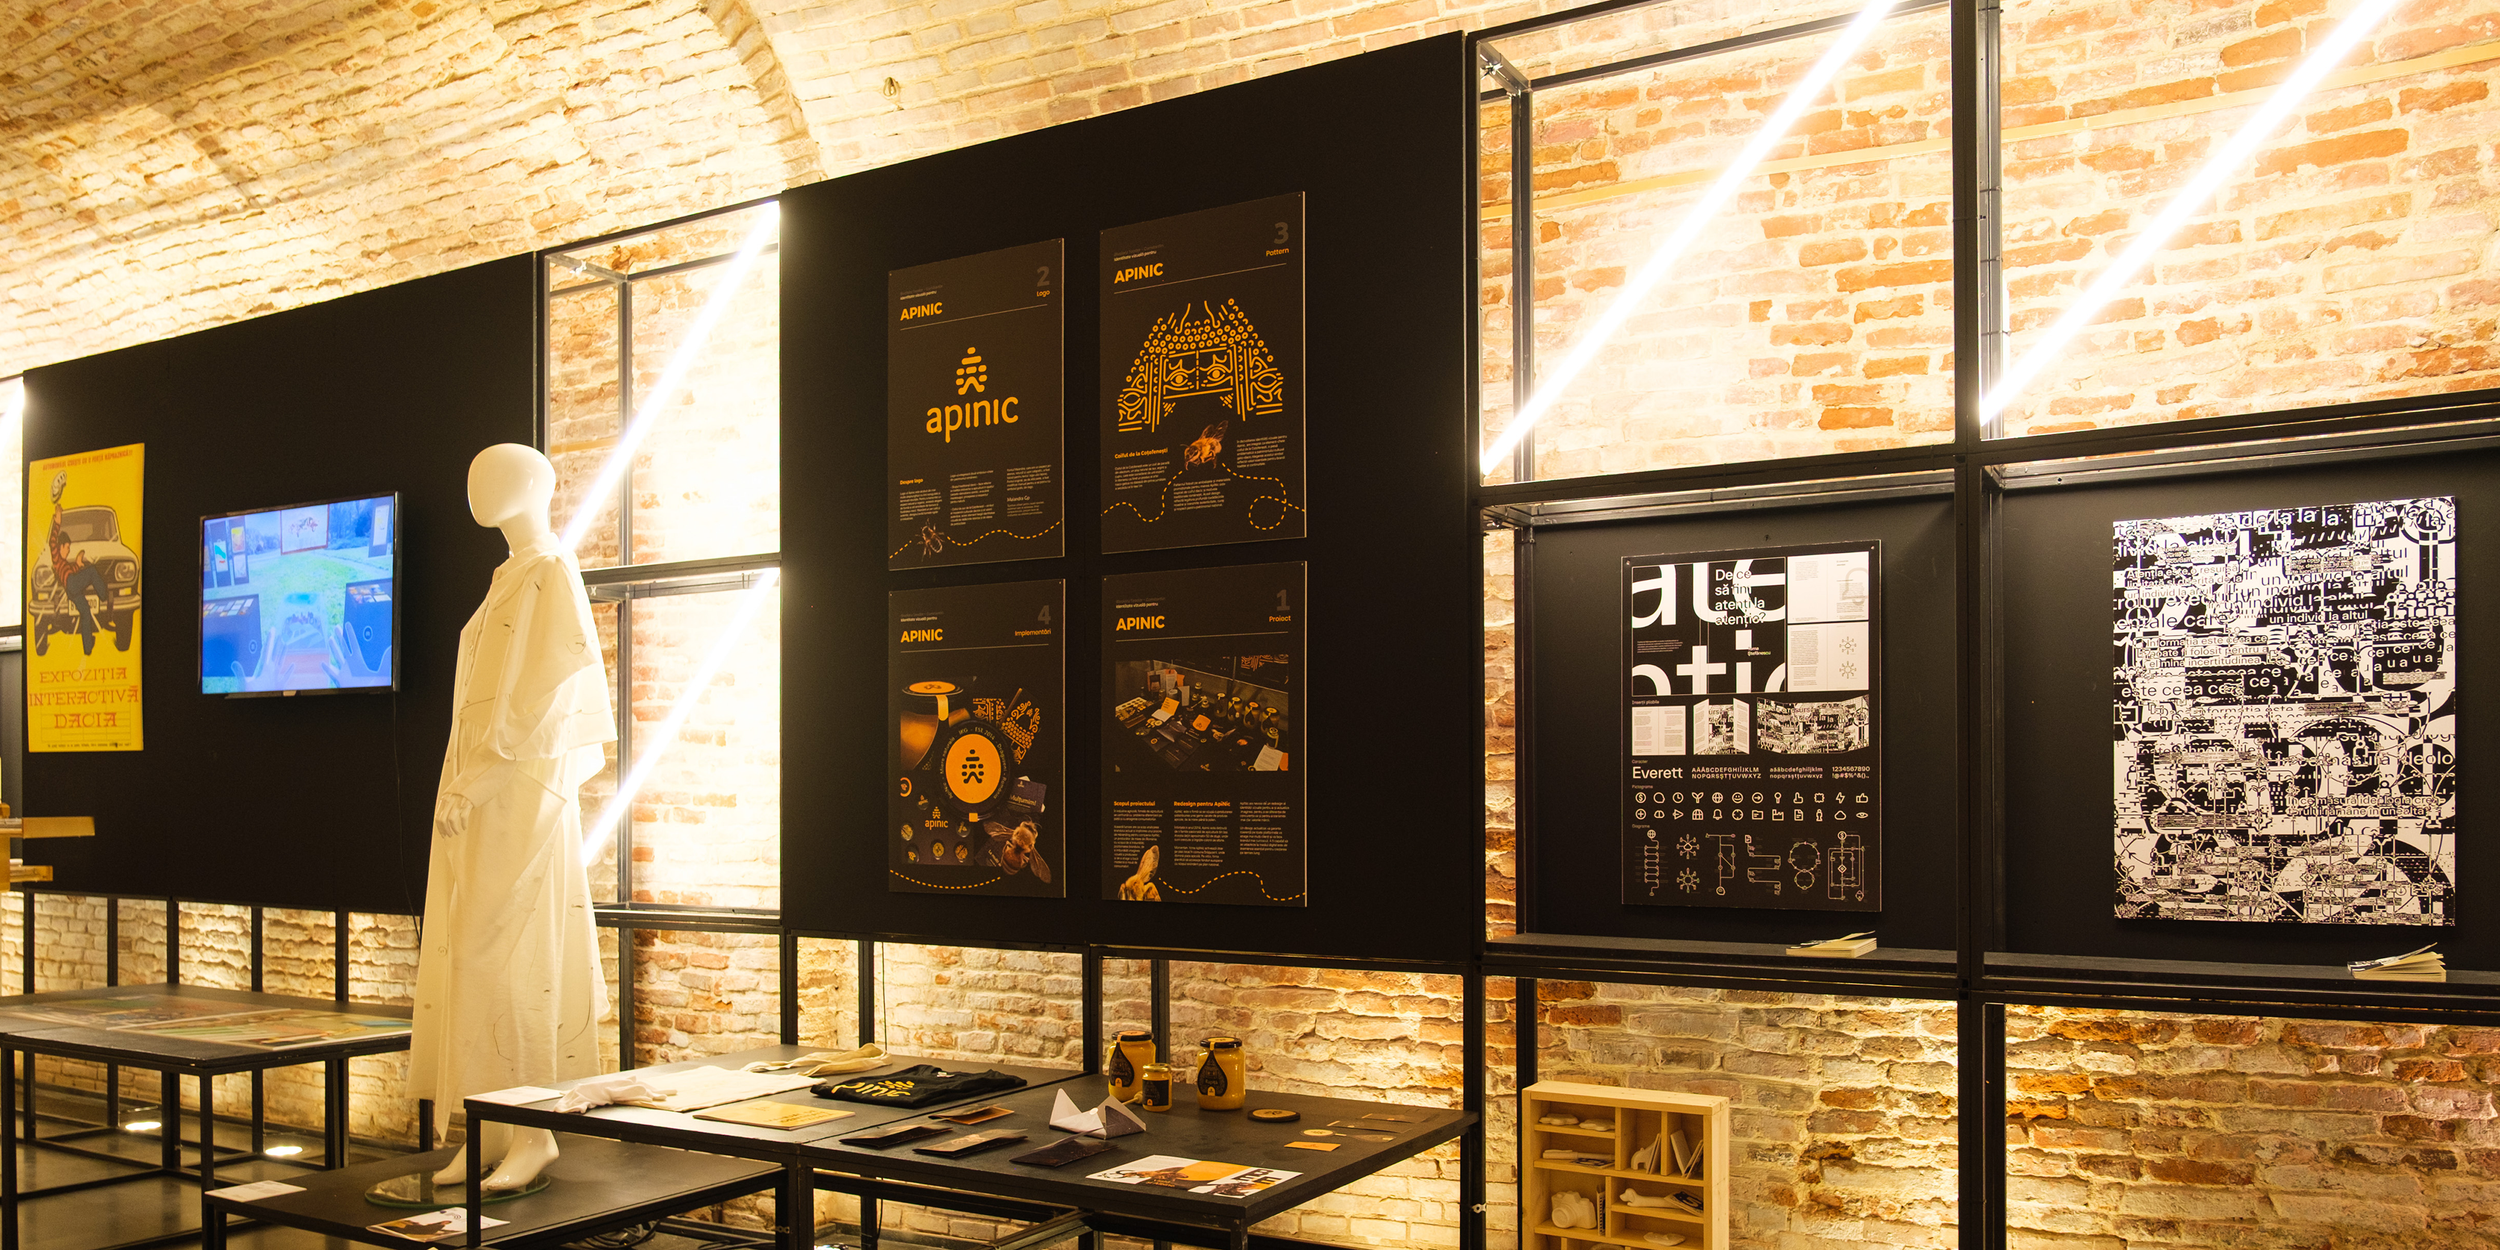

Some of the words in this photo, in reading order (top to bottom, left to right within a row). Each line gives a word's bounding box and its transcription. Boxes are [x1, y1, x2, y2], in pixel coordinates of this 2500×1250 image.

[1273, 221, 1290, 245] 3
[1265, 247, 1290, 257] Pattern
[1036, 265, 1050, 288] 2
[1113, 262, 1164, 284] APINIC
[1036, 289, 1051, 298] Logo
[900, 301, 943, 321] APINIC
[926, 396, 1019, 443] apinic
[1715, 569, 1733, 581] De
[1715, 584, 1730, 596] să
[1276, 588, 1291, 612] 1
[1037, 604, 1052, 625] 4
[1268, 614, 1292, 623] Proiect
[2269, 614, 2284, 624] un
[2328, 611, 2343, 622] la
[2346, 609, 2369, 621] altul
[1115, 615, 1166, 631] APINIC
[900, 628, 943, 643] APINIC
[2188, 655, 2261, 667] incertitudinea
[39, 667, 128, 684] EXPOZIȚIA
[28, 685, 140, 707] INTERACTIVĂ
[53, 711, 118, 729] DACIA
[1632, 766, 1684, 779] Everett
[924, 820, 949, 831] apinic
